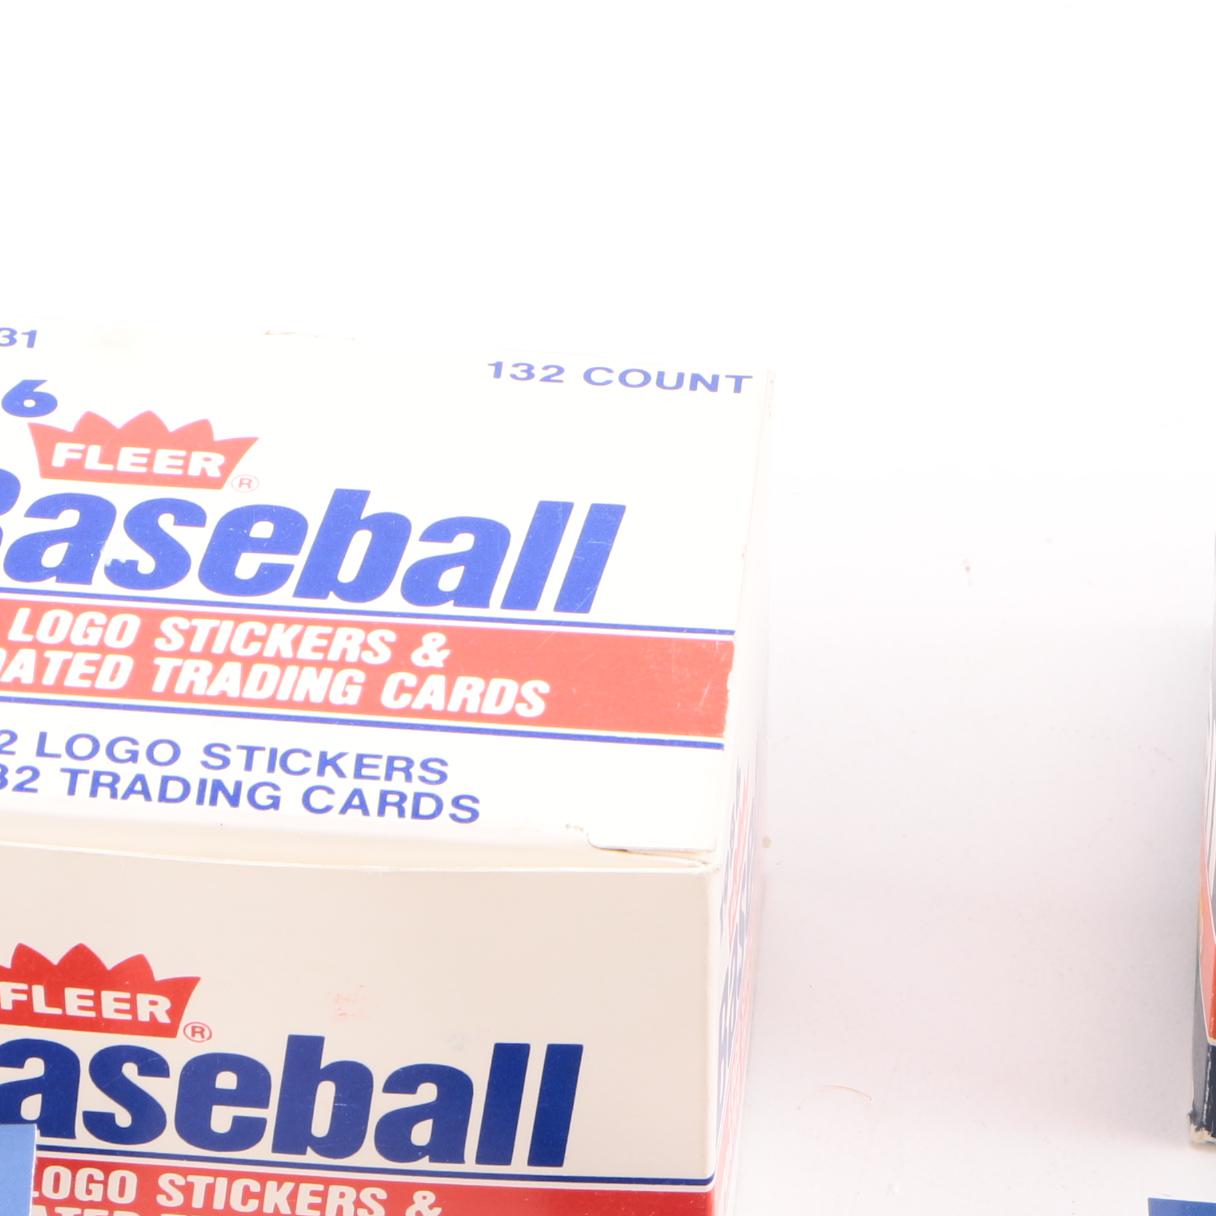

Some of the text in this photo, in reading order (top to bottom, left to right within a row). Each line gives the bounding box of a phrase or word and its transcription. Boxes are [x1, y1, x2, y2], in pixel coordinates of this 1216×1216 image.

[1, 379, 58, 418] 6
[487, 361, 753, 395] 132 COUNT
[51, 442, 226, 479] FLEER
[0, 468, 626, 614] aseball
[8, 607, 450, 667] LOGO STICKERS &
[0, 647, 550, 718] ATED TRADING CARDS
[36, 731, 181, 767] LOGO
[200, 742, 449, 785] STICKERS
[60, 768, 282, 811] TRADING
[301, 785, 480, 824] CARDS
[0, 981, 172, 1024] FLEER
[32, 1164, 138, 1204] OGO
